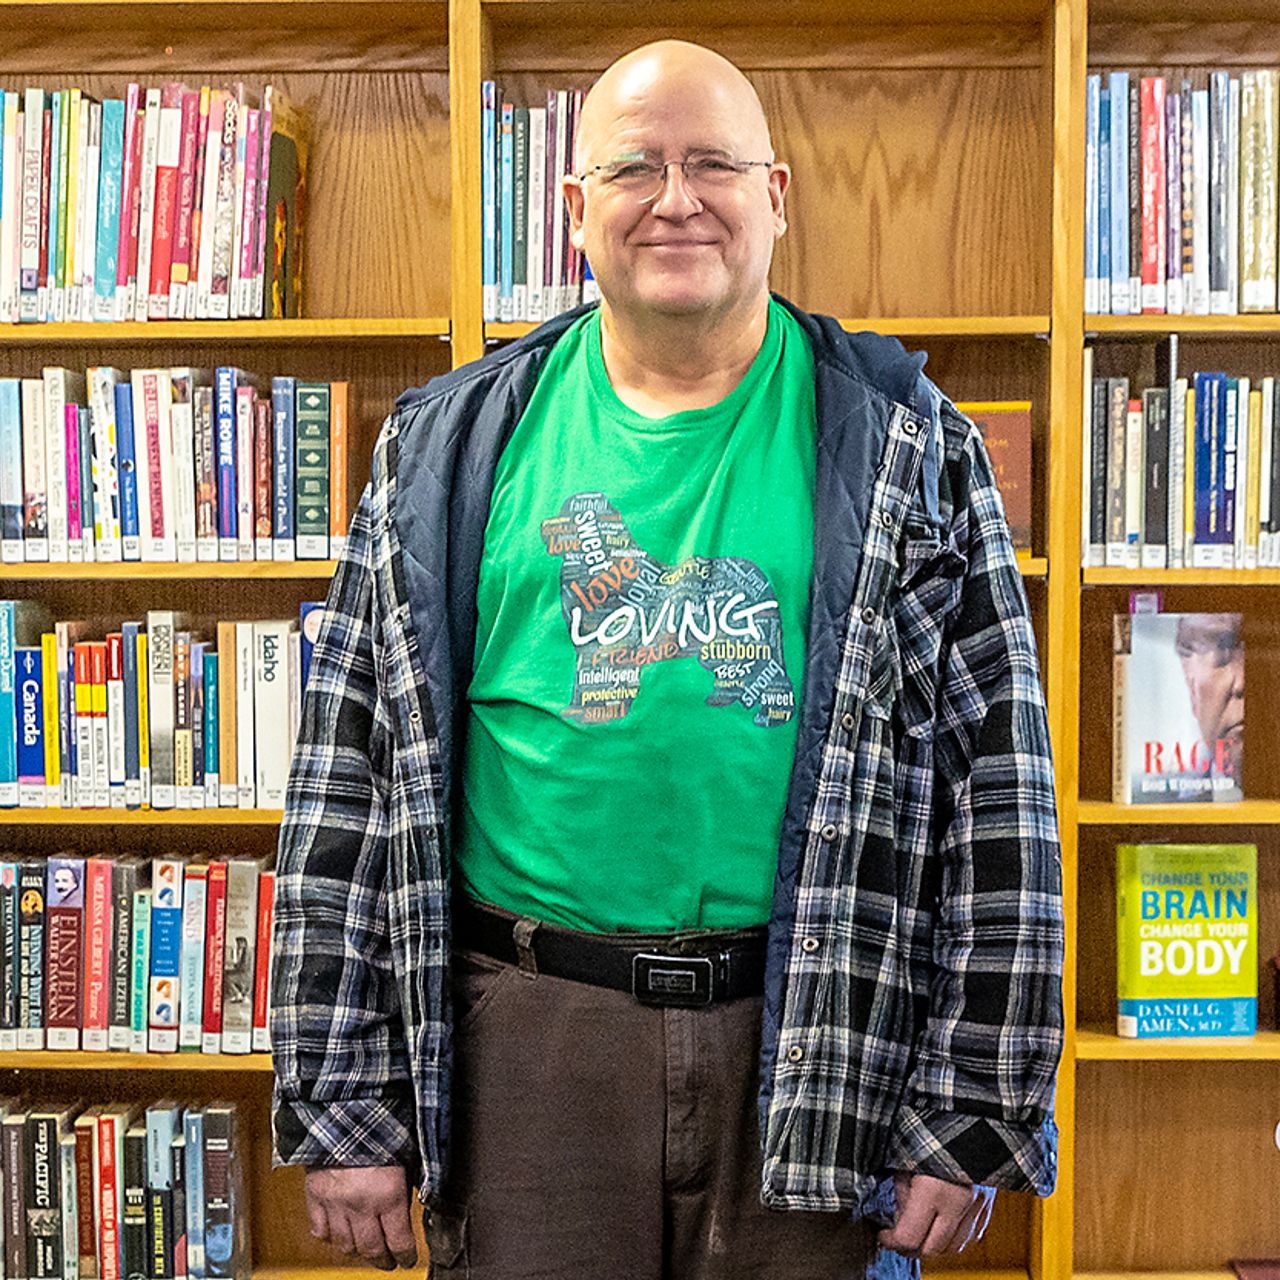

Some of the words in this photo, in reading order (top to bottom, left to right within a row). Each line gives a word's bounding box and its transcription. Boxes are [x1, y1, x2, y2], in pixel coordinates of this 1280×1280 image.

[224, 99, 238, 144] Socks
[24, 149, 40, 193] PAPER
[515, 122, 525, 177] MATERIAL
[24, 196, 40, 249] CRAFTS
[515, 180, 525, 242] OBSESSION
[219, 373, 232, 415] MIKE
[219, 418, 232, 465] ROWE
[548, 535, 583, 555] love
[574, 510, 614, 576] sweet
[570, 556, 640, 613] love
[618, 558, 661, 610] loyal
[570, 593, 779, 648] LOVING
[176, 638, 187, 671] GARY
[263, 634, 279, 682] Idaho
[591, 641, 680, 668] FRIEND
[700, 638, 772, 661] stubborn
[714, 661, 756, 680] BEST
[176, 673, 187, 725] PAULSEN
[581, 687, 639, 707] protective
[740, 659, 787, 708] strong
[761, 691, 795, 707] sweet
[22, 679, 40, 746] Canada
[767, 707, 792, 722] hairy
[1143, 738, 1234, 775] RAGE
[92, 875, 105, 924] MELISSA
[1140, 872, 1203, 887] CHANGE
[1208, 872, 1249, 886] YOUR
[1141, 888, 1248, 921] BRAIN
[91, 927, 104, 975] GILBERT
[115, 909, 129, 973] AMERICAN
[1139, 922, 1204, 939] CHANGE
[1207, 922, 1250, 939] YOUR
[60, 915, 78, 1020] EINSTEIN
[1139, 938, 1249, 977] BODY
[89, 982, 103, 1020] Prairie
[1138, 1002, 1204, 1018] DANIEL
[35, 1143, 50, 1207] PACIFIC
